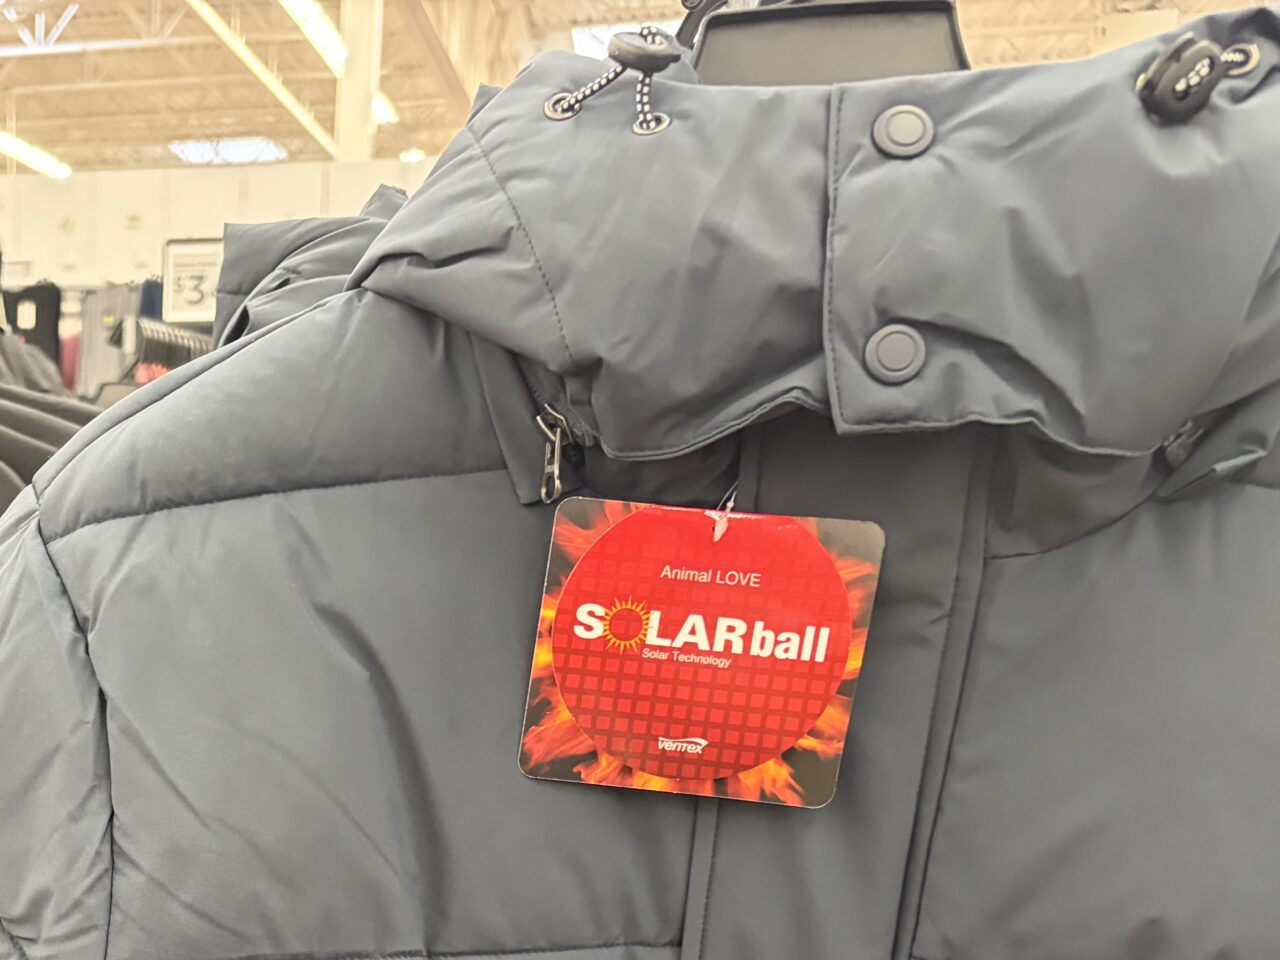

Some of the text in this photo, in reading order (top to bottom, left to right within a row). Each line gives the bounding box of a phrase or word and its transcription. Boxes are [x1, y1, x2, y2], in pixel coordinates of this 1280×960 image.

[660, 565, 762, 588] Animal LOVE
[642, 648, 732, 668] Solar Technology
